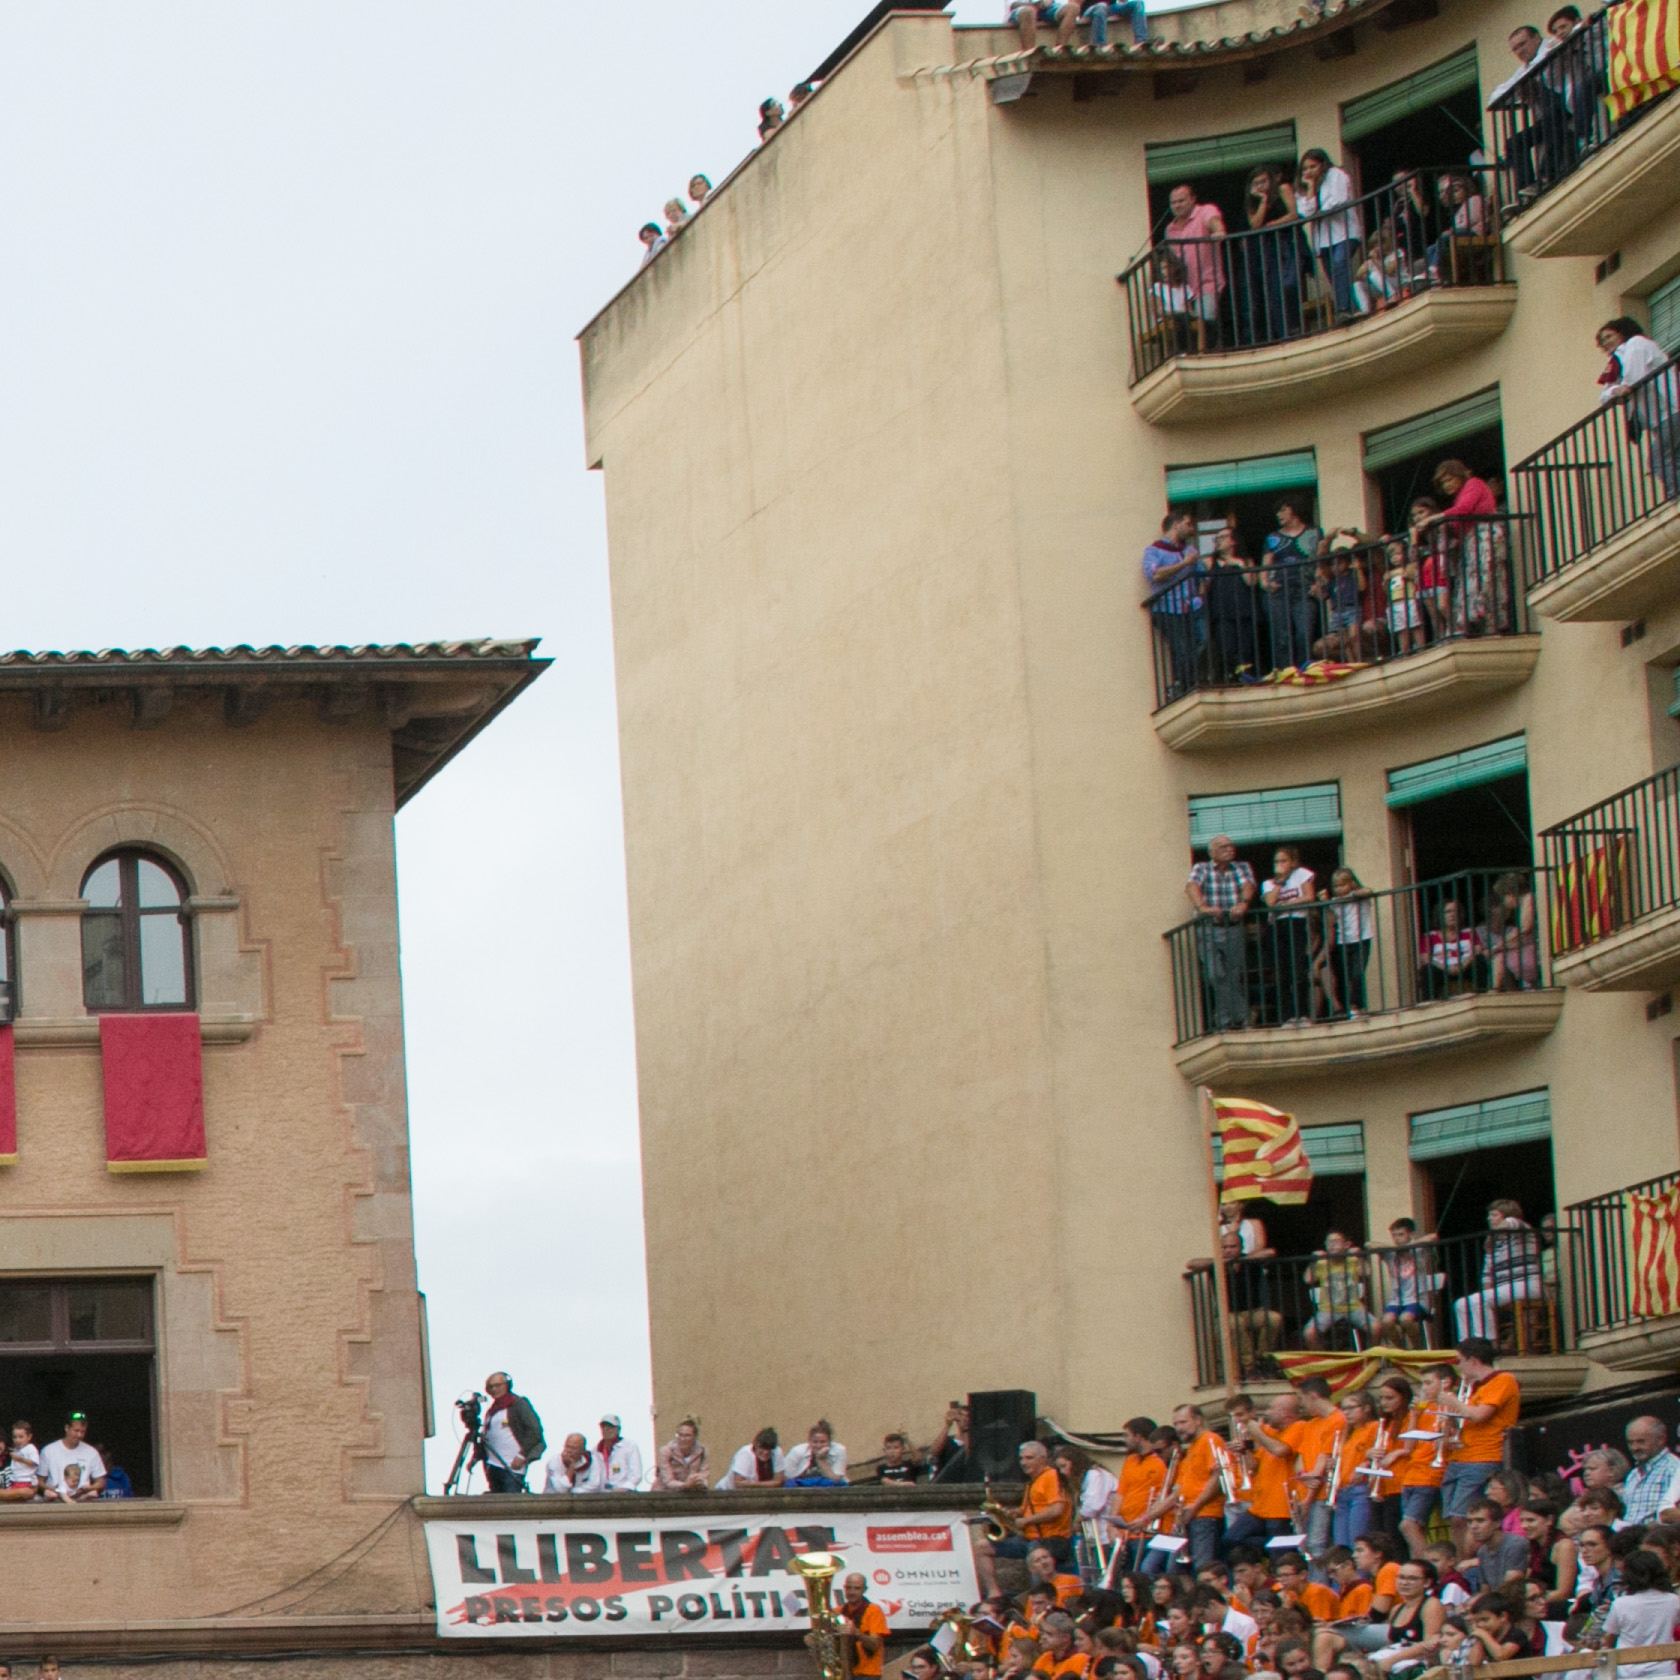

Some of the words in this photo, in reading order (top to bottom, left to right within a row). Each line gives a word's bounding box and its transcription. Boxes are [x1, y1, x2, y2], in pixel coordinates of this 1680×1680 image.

[875, 1531, 948, 1541] assemblea.cat
[456, 1526, 836, 1584] LLIBERTAT
[895, 1568, 960, 1579] ÒMNIUM
[465, 1594, 629, 1625] PRESOS
